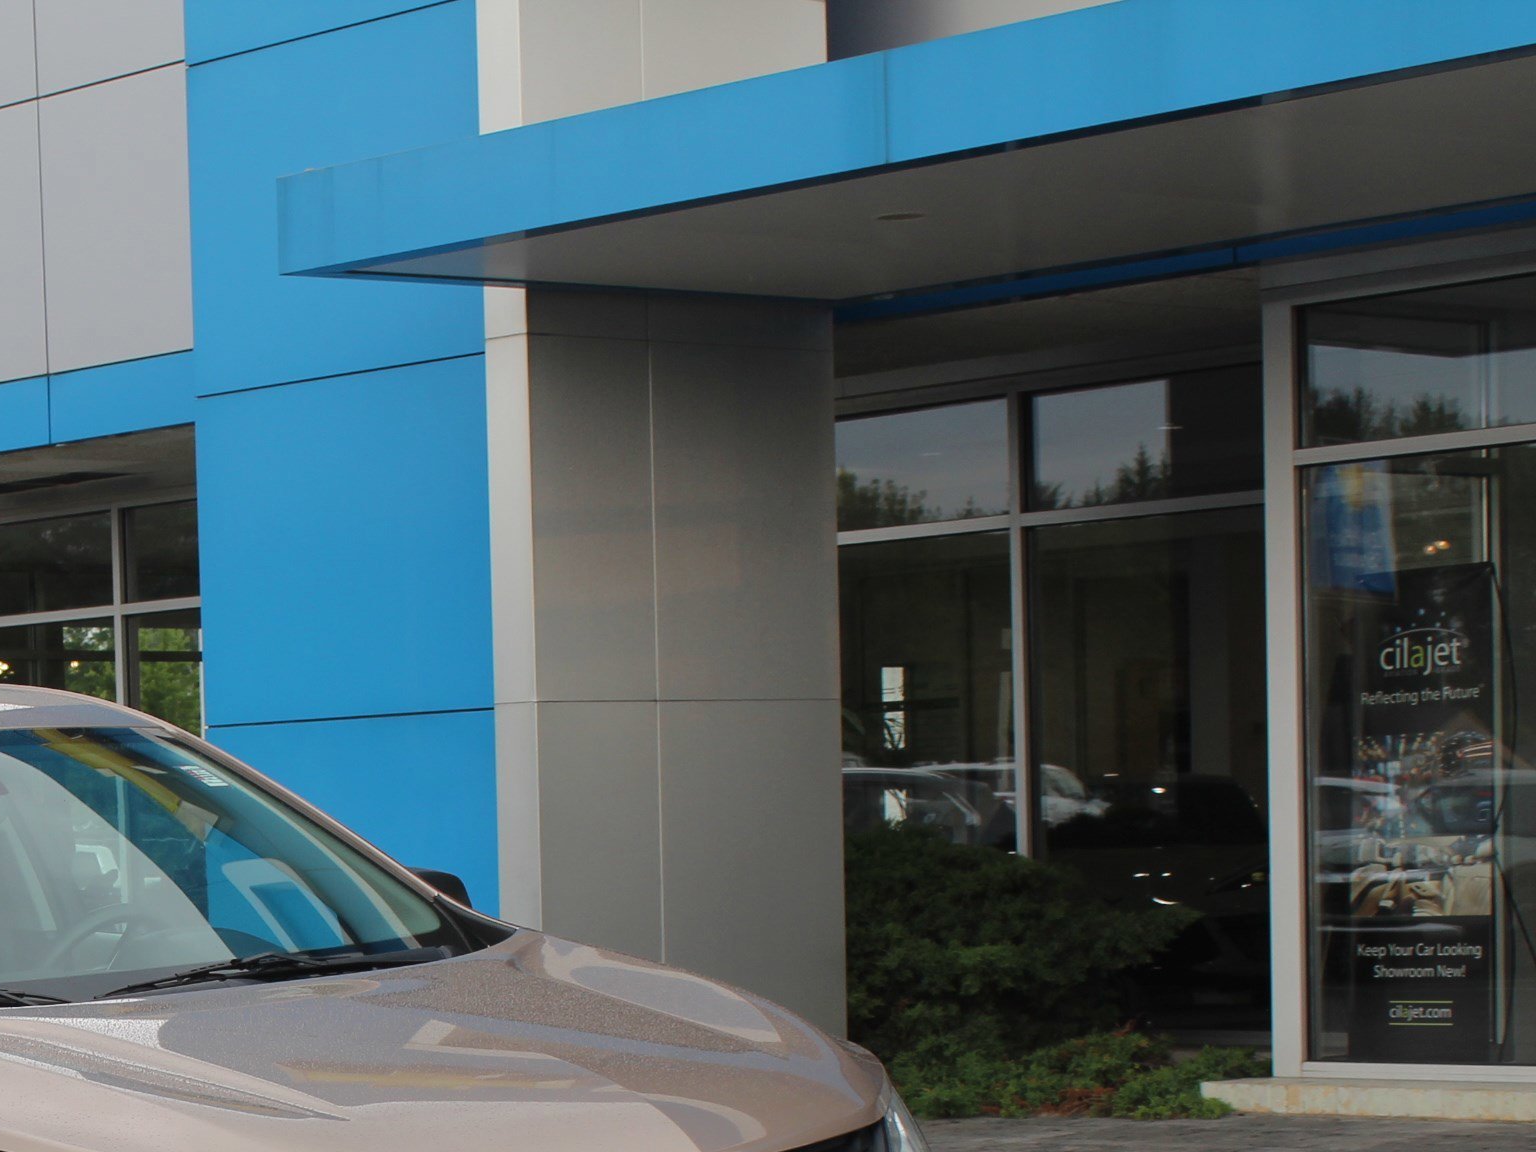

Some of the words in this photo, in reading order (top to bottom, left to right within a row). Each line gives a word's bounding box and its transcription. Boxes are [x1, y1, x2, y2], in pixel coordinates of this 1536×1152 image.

[1380, 637, 1462, 676] cilajet
[1360, 690, 1418, 706] Reflecting
[1420, 687, 1441, 702] the
[1357, 944, 1386, 959] Keep
[1388, 944, 1414, 956] Your
[1415, 942, 1435, 957] Car
[1437, 943, 1482, 959] Looking
[1373, 964, 1435, 978] Showroom
[1436, 964, 1467, 978] New!
[1389, 1004, 1452, 1021] cilajet.com
